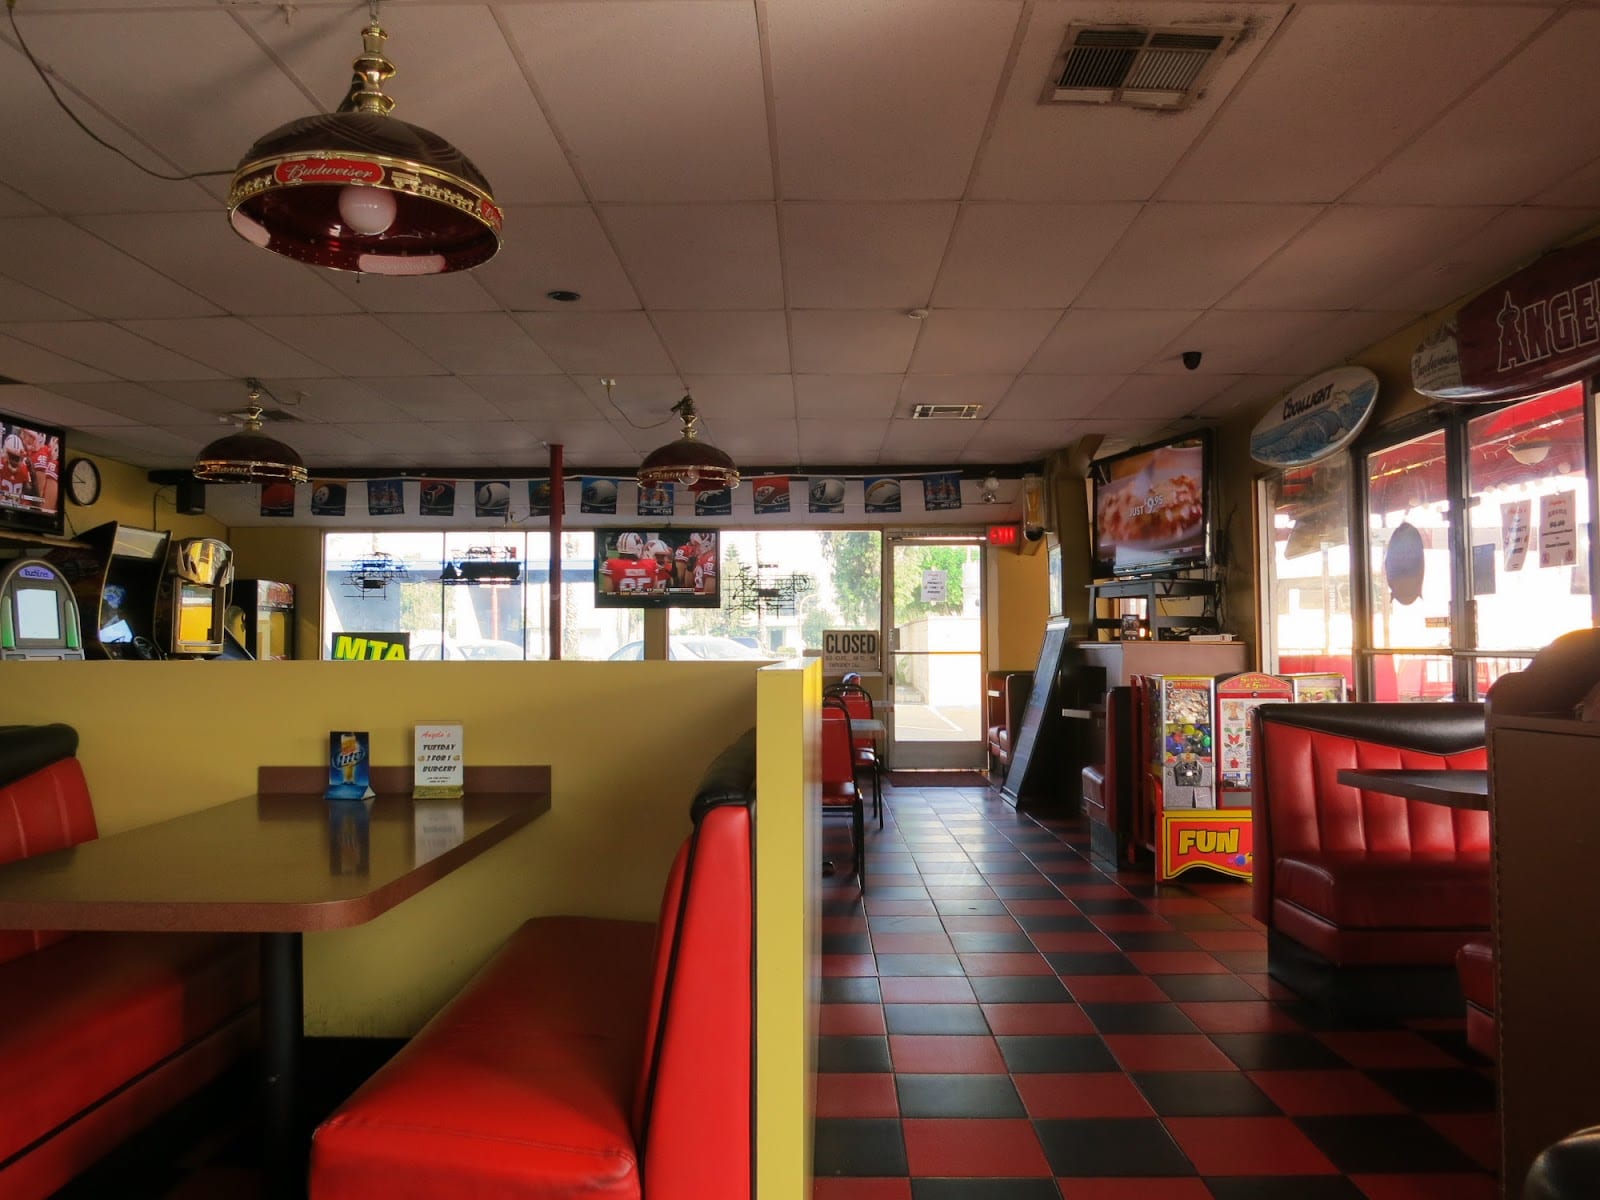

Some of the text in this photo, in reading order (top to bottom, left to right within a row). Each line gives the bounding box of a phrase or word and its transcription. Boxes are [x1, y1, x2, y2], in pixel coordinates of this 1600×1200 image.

[285, 161, 375, 180] Budweiser
[1497, 278, 1600, 373] ANGE
[1128, 505, 1144, 517] JUST
[826, 634, 876, 654] CLOSED
[1178, 828, 1240, 854] FUN
